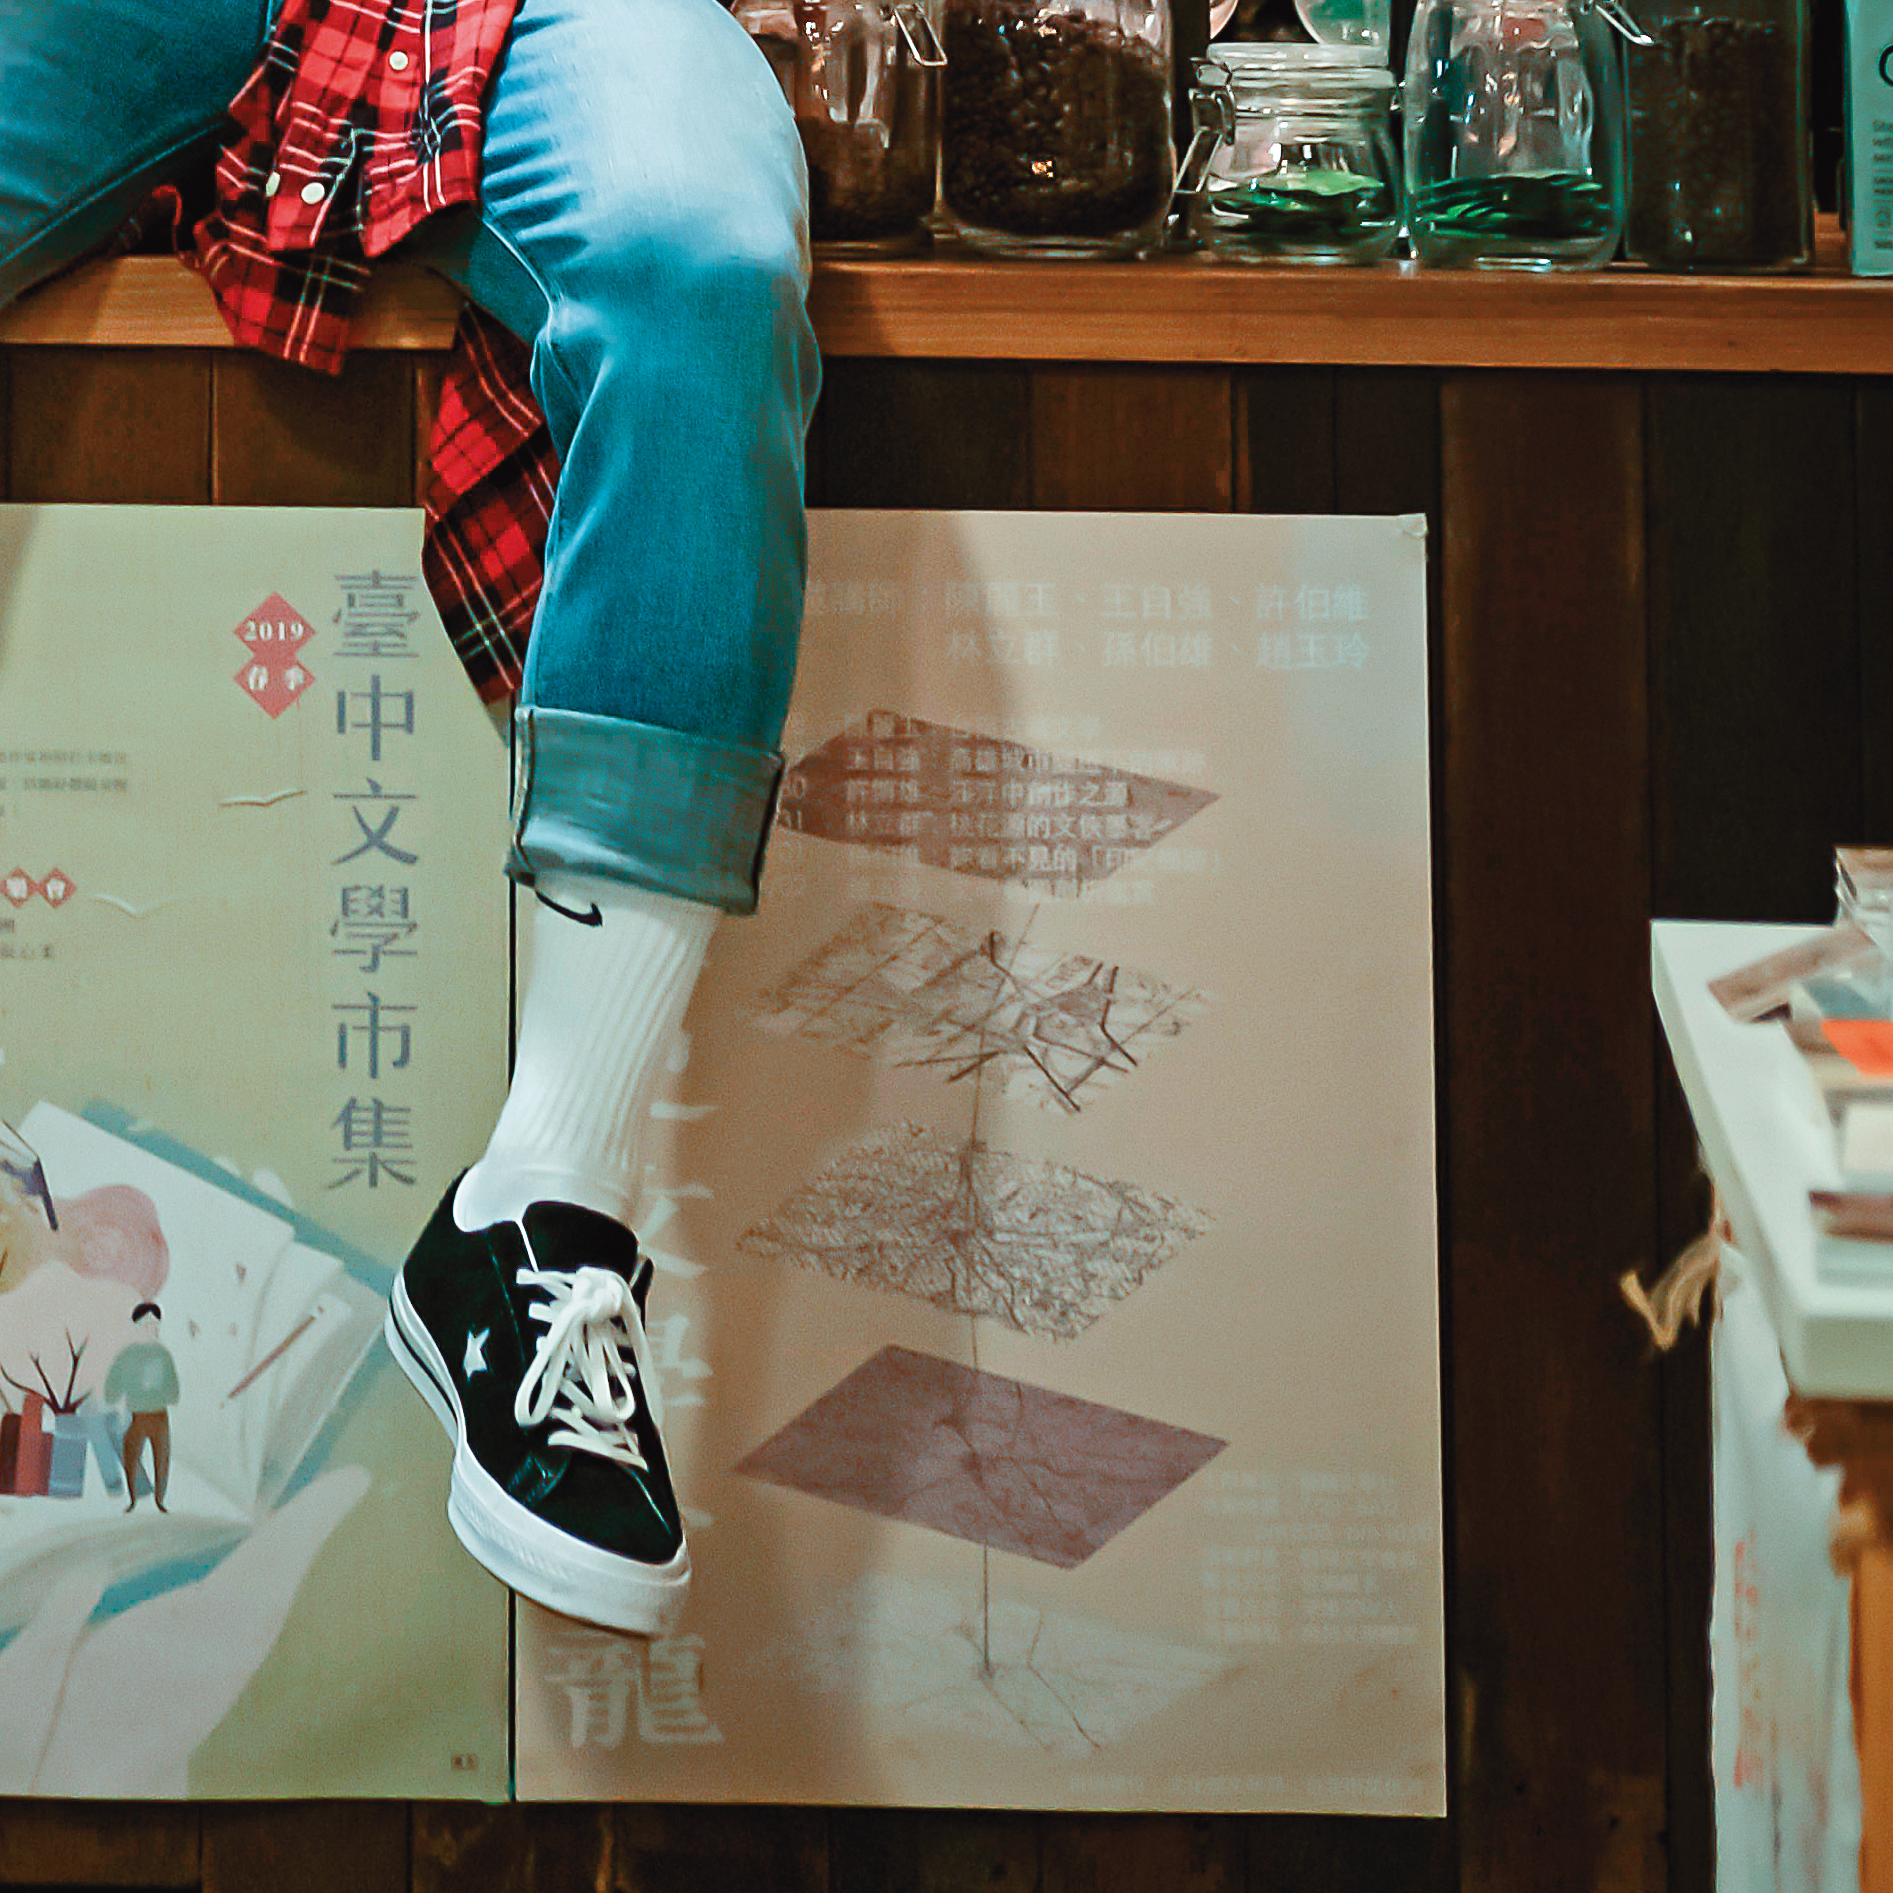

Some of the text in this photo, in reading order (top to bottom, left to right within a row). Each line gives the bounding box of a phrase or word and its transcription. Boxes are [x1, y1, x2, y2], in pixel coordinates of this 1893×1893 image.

[243, 620, 305, 642] 2019
[330, 569, 420, 1190] 臺中文學市集
